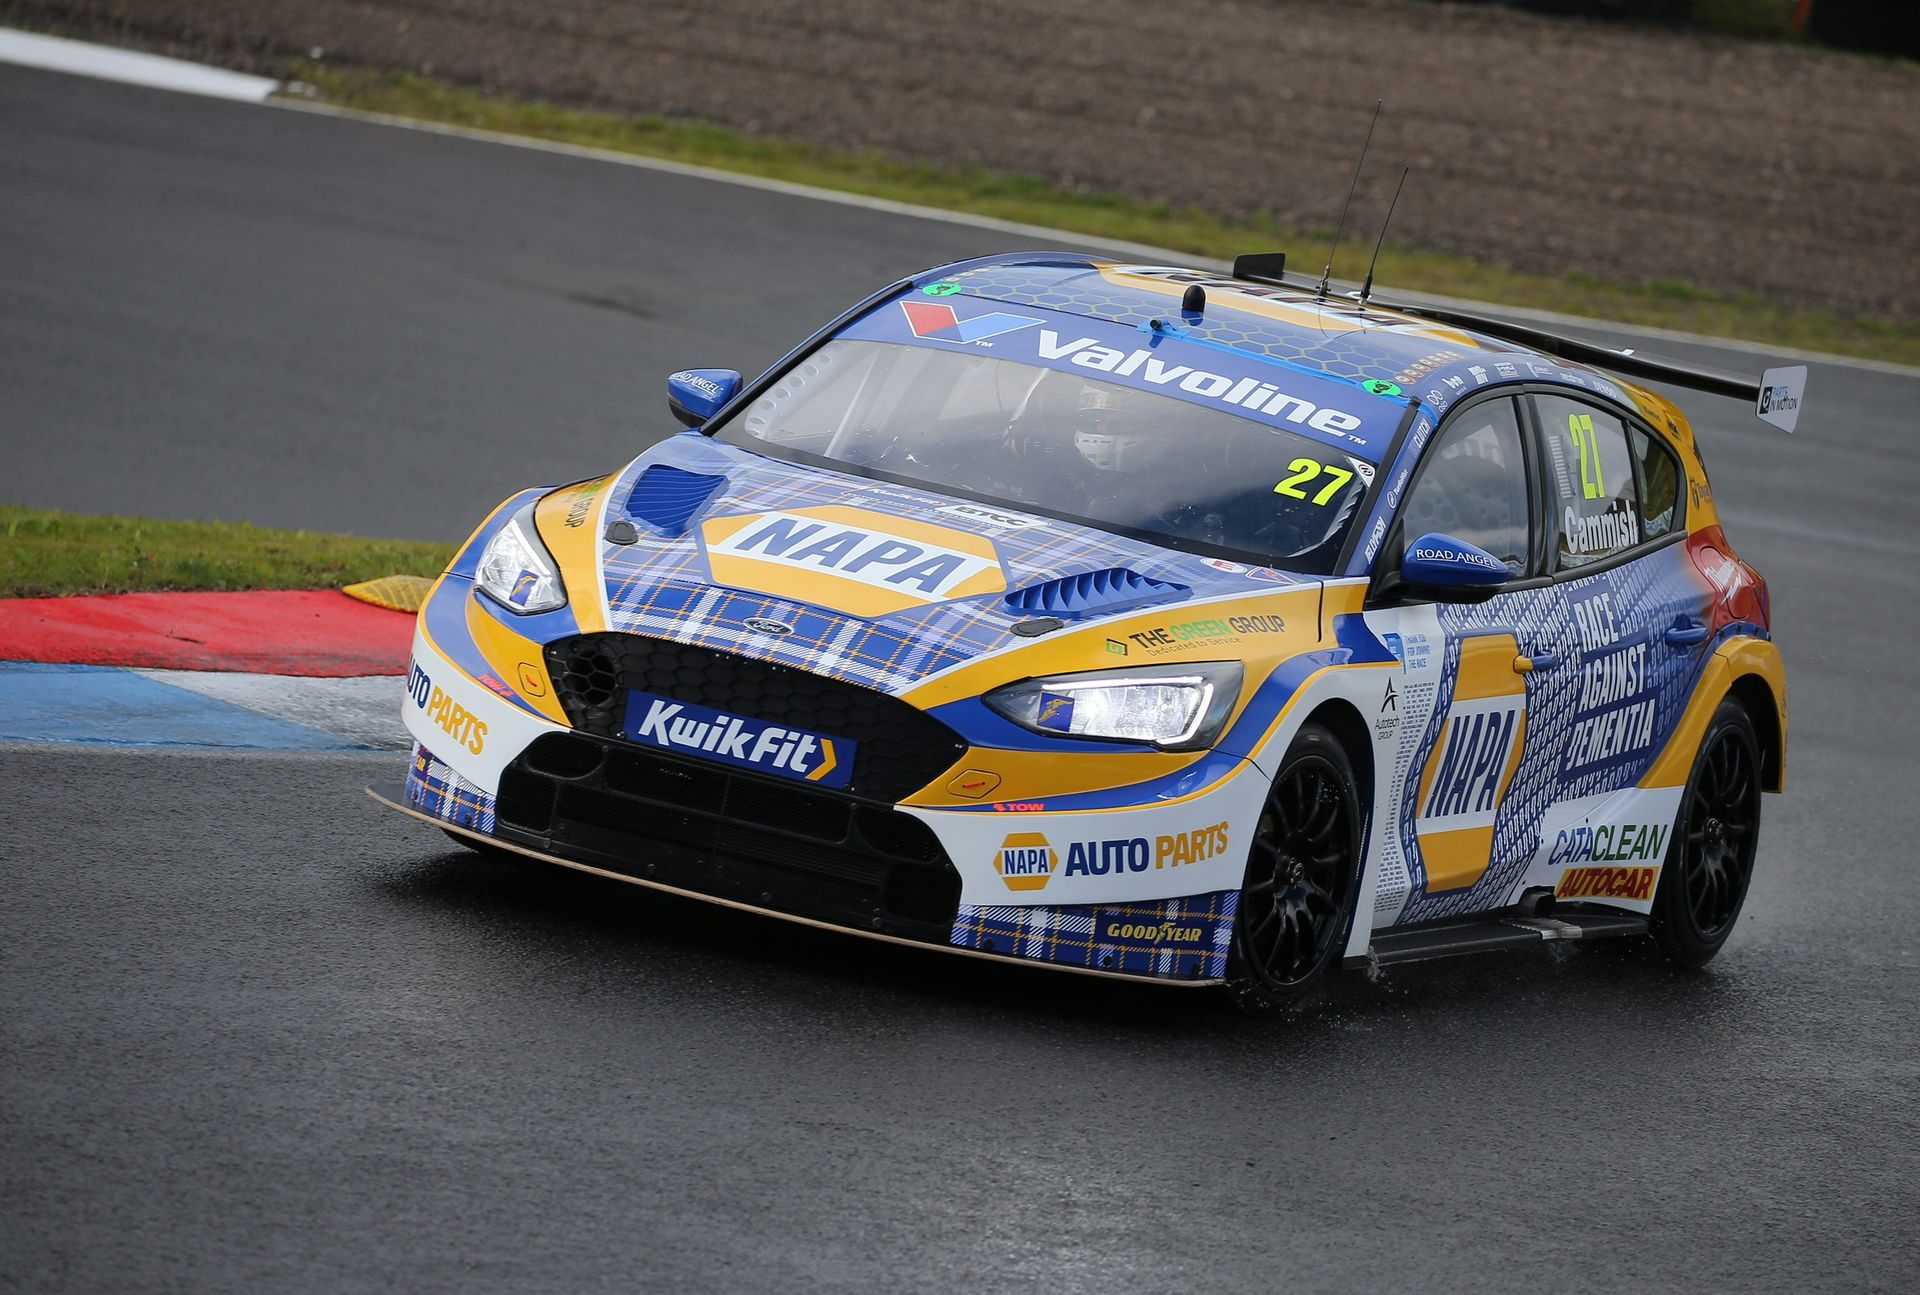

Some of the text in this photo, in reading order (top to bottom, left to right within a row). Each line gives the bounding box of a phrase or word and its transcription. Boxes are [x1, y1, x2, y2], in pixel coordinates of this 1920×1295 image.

[690, 375, 720, 394] ANGEL
[1039, 329, 1362, 437] Valvoline
[1568, 413, 1606, 499] 27
[1273, 457, 1354, 507] 27
[954, 506, 1029, 526] BTCC
[1564, 499, 1639, 554] Cammish
[734, 518, 967, 594] NAPA
[1416, 549, 1496, 568] ROAD ANGEL
[1129, 615, 1285, 649] THE GREEN GROUP
[1574, 592, 1619, 653] RACE
[1146, 635, 1242, 657] Dedicated to Service
[1577, 643, 1646, 713] AGAINST
[426, 685, 489, 756] PARTS
[1375, 715, 1400, 730] Autotech
[1378, 730, 1394, 741] GROUP
[1565, 699, 1656, 770] DEMENTIA
[1425, 710, 1516, 819] NAPA
[1007, 803, 1045, 812] TOW
[1004, 849, 1049, 875] NAPA
[1065, 821, 1229, 877] AUTO PARTS
[1548, 824, 1669, 866] CATACLEAN
[1556, 868, 1654, 899] AUTOCAR
